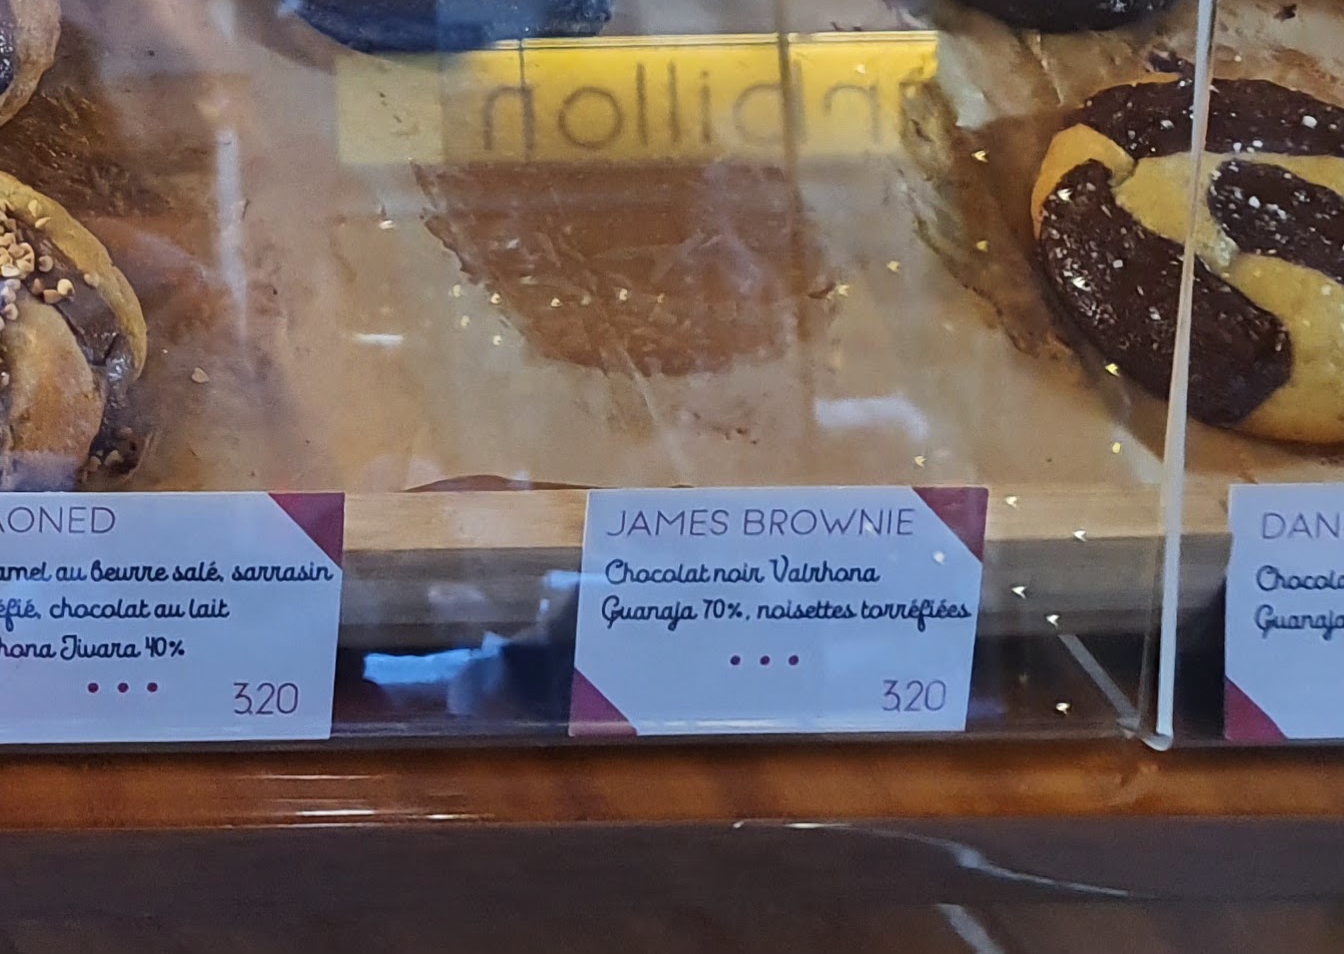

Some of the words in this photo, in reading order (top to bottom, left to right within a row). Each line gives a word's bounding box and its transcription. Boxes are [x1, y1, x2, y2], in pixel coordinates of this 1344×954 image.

[605, 507, 729, 537] JAMES
[742, 507, 916, 537] BROWNIE
[54, 565, 88, 582] au
[90, 559, 170, 582] beurre
[171, 560, 225, 583] salé,
[230, 561, 335, 582] sarrasin
[604, 558, 711, 585] Chocolat
[712, 561, 765, 584] noir
[768, 554, 881, 583] Valrhona
[48, 596, 151, 619] chocolat
[153, 604, 187, 619] au
[188, 598, 231, 619] lait
[601, 594, 699, 631] Guanaja
[756, 598, 857, 621] noisettes
[860, 598, 972, 632] torréfiées
[59, 635, 142, 660] Jivara
[144, 636, 186, 658] 40%
